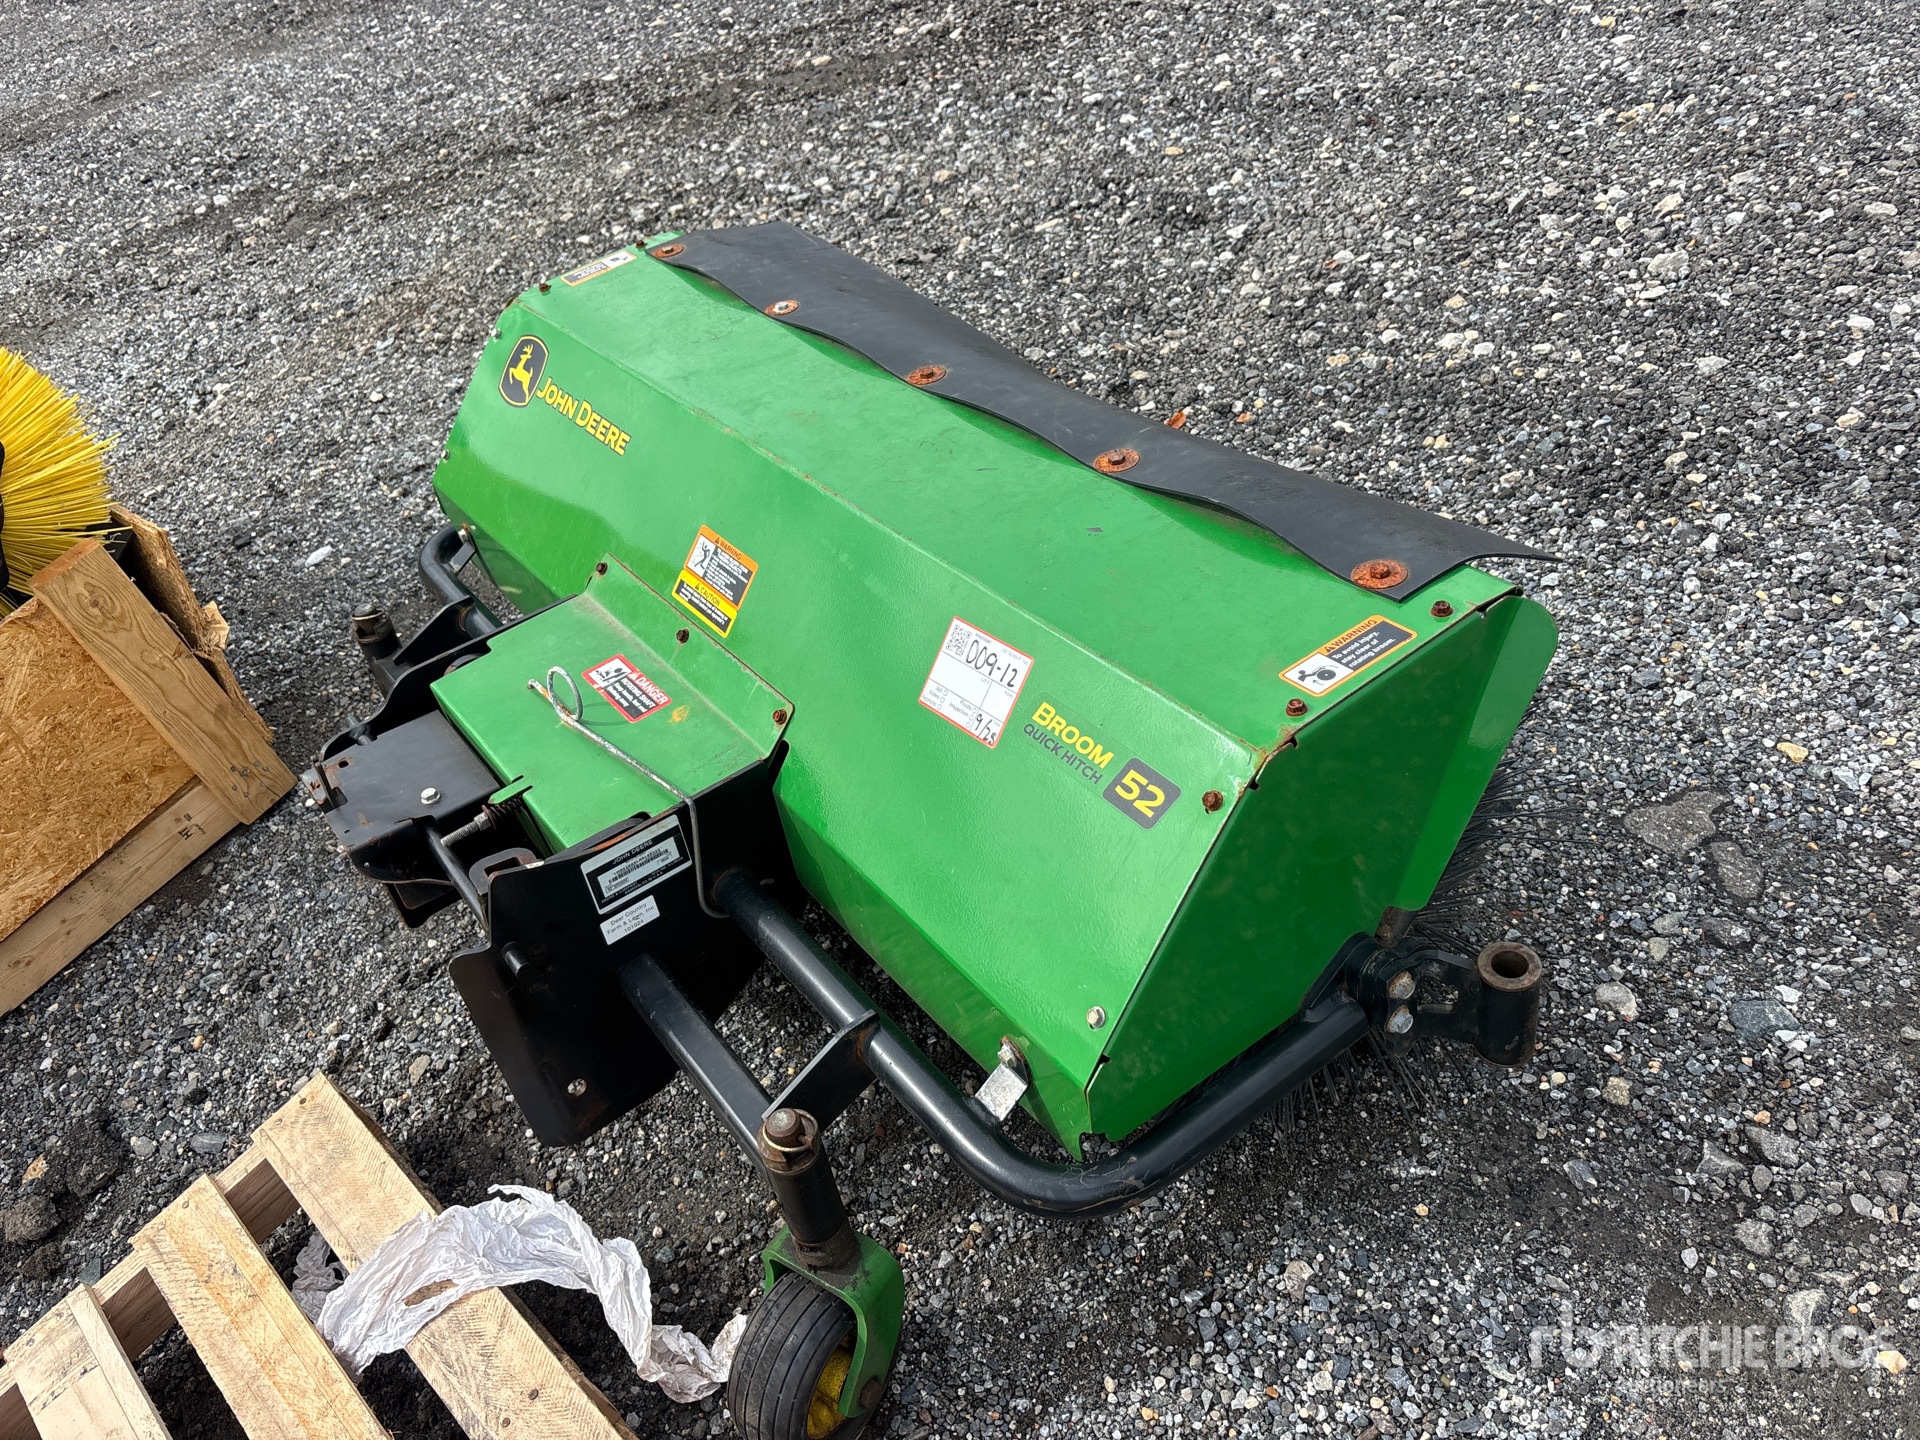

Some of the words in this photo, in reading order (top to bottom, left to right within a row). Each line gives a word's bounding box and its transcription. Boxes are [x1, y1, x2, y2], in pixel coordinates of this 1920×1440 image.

[536, 376, 579, 420] JOHN
[575, 400, 632, 456] DEERE
[719, 542, 742, 561] WARNING
[700, 587, 721, 606] CAUTION
[1332, 652, 1343, 660] To
[1342, 641, 1359, 654] avoid
[1360, 631, 1380, 645] injury,
[1333, 619, 1377, 647] WARNING
[965, 639, 1018, 688] 009-12
[1341, 654, 1355, 664] stay
[1356, 644, 1371, 654] clear
[1348, 652, 1375, 668] rotating
[1374, 638, 1396, 654] broom.
[636, 677, 668, 705] DANGER
[1032, 702, 1114, 769] BROOM
[1024, 723, 1064, 756] QUICK
[1061, 750, 1103, 784] HITCH
[1114, 769, 1165, 818] 52
[178, 827, 193, 841] HT
[612, 851, 631, 865] JOHN
[631, 840, 654, 854] DEERE
[610, 915, 624, 926] Deer
[625, 902, 647, 916] Country
[624, 919, 644, 933] 101024
[607, 923, 623, 935] Farm
